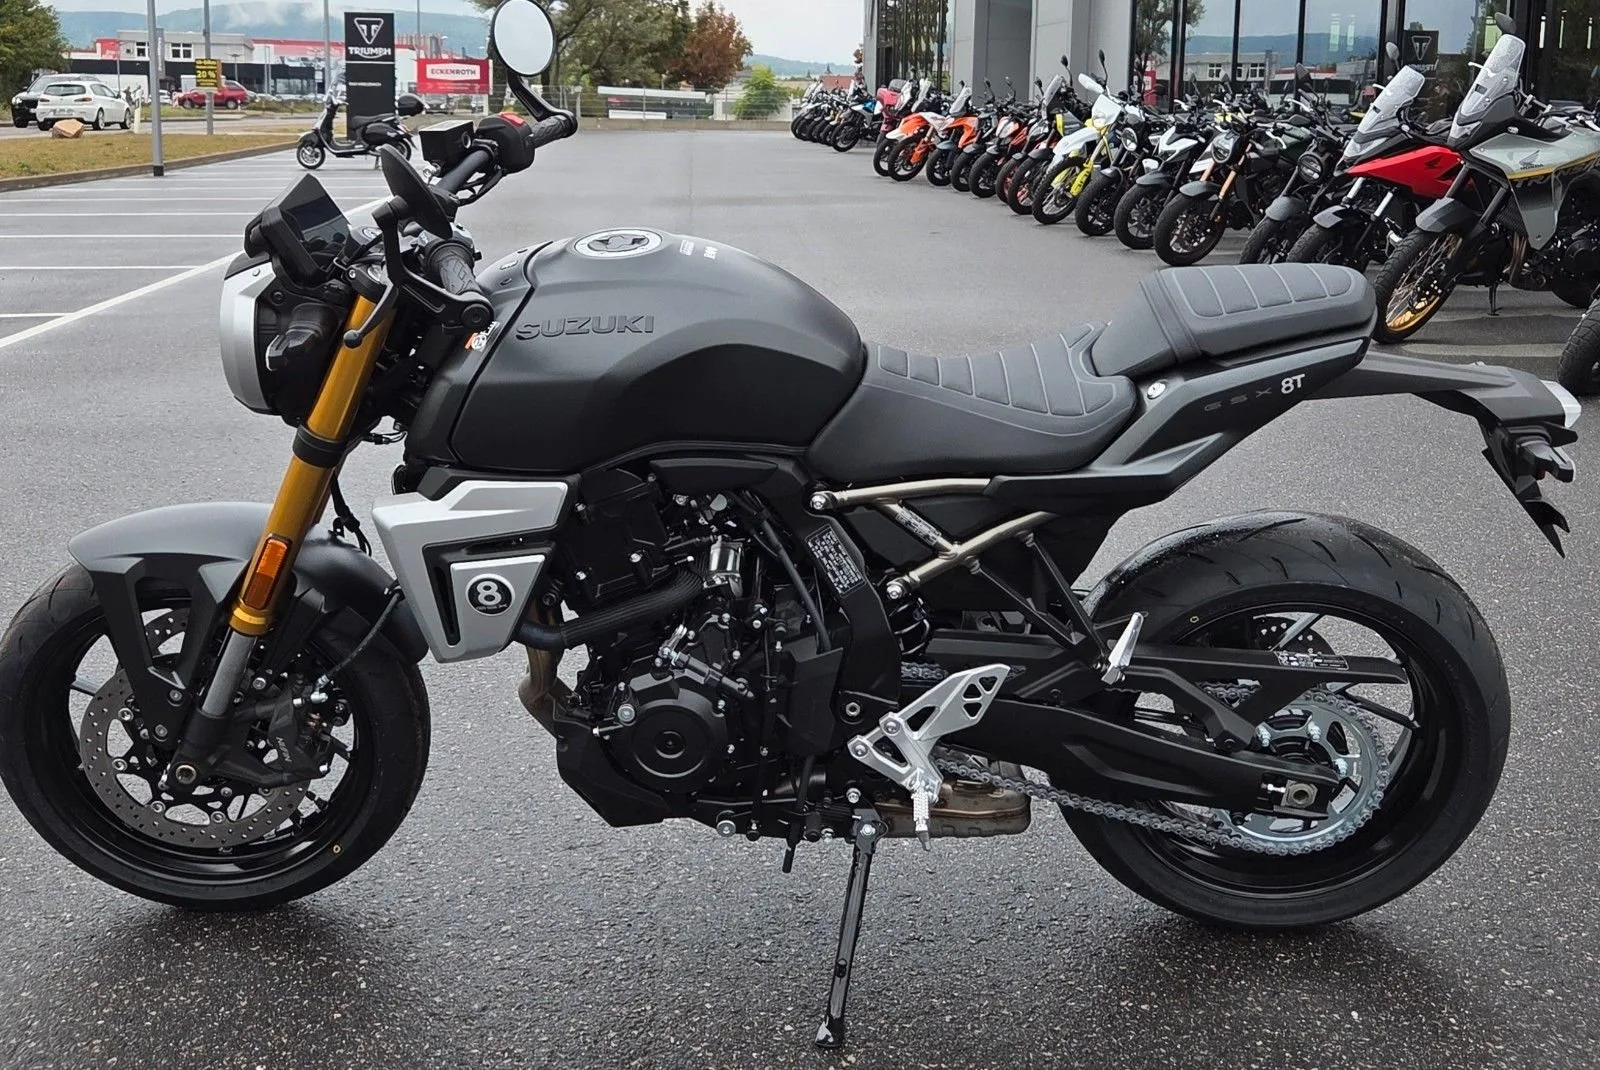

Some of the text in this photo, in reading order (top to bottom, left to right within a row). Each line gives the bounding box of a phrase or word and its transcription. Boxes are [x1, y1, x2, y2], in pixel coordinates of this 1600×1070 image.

[348, 46, 392, 58] TRIUMPH
[196, 70, 207, 79] 20
[515, 315, 655, 341] SUZUKI
[1280, 373, 1306, 394] 8T
[476, 581, 502, 607] 8
